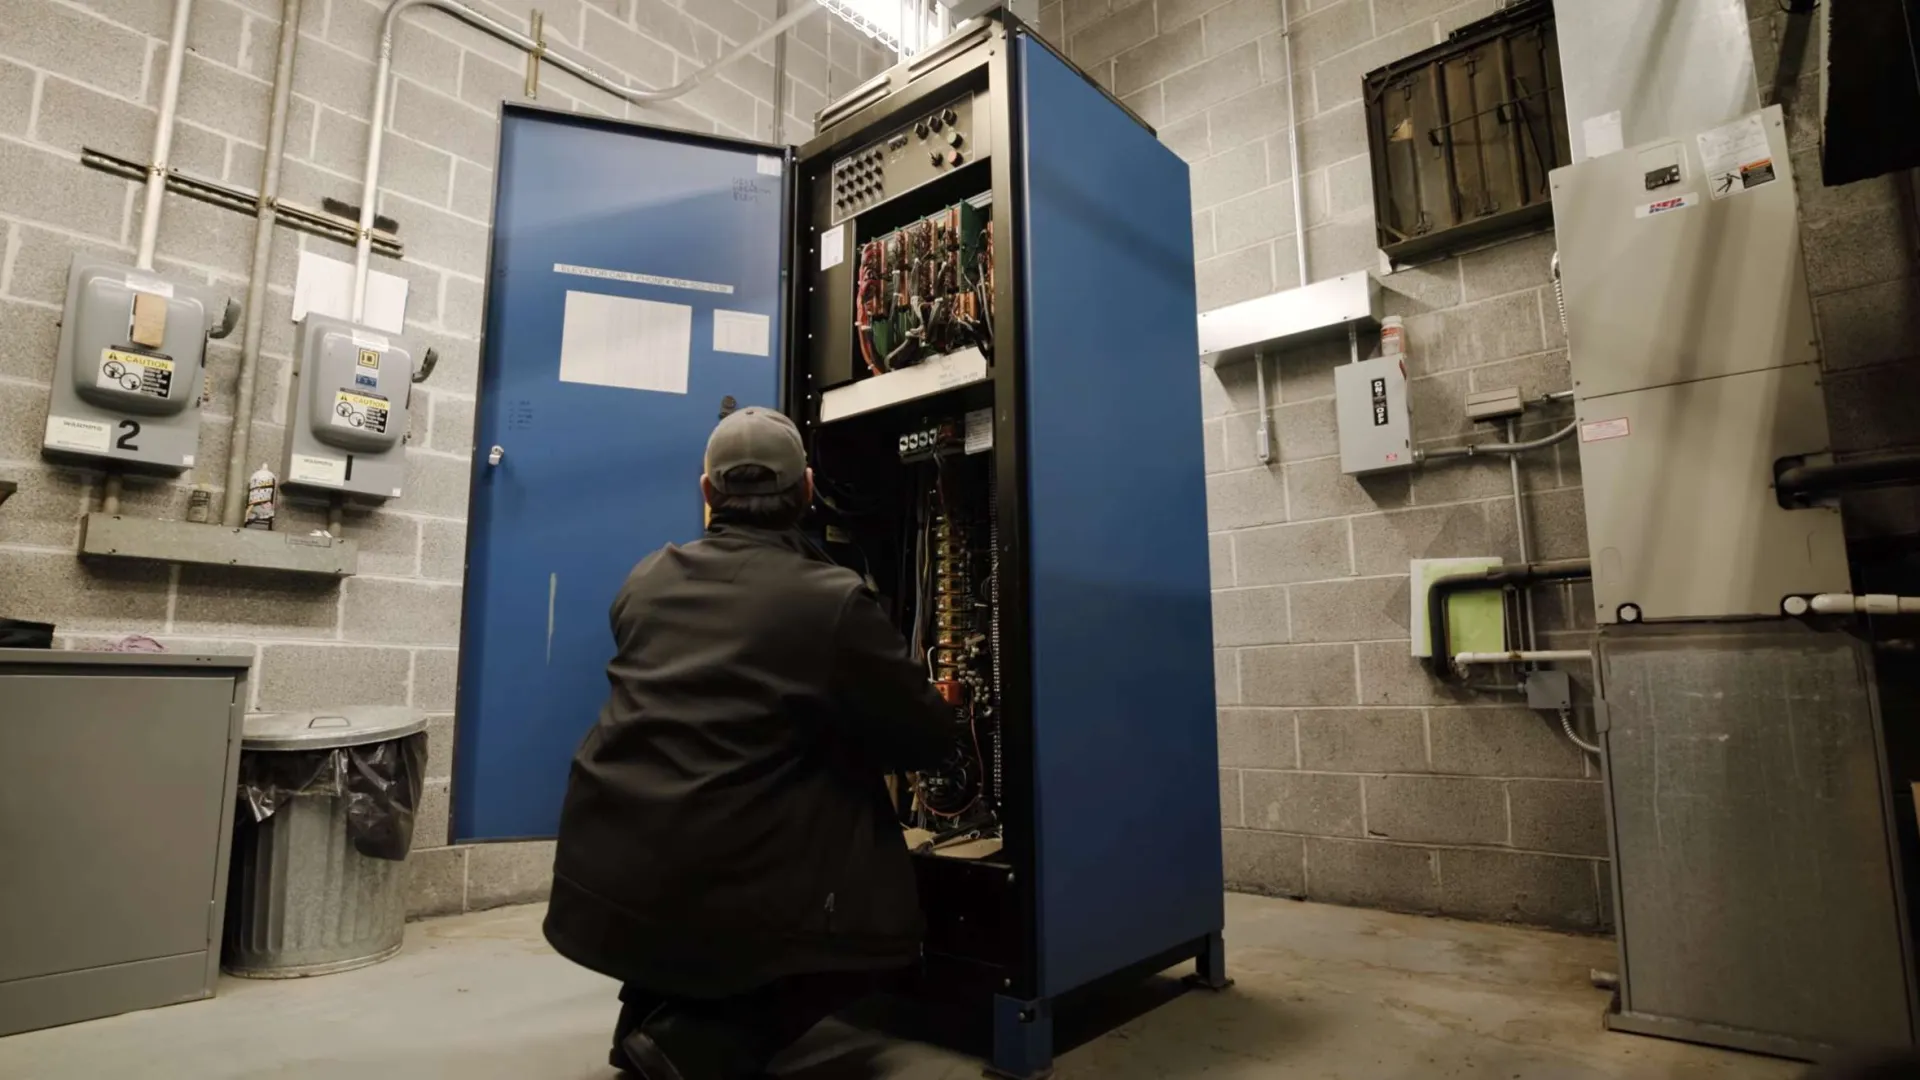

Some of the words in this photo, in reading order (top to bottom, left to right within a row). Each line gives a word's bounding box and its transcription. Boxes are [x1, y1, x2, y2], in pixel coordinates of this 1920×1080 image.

[561, 265, 607, 277] ELEVATOR
[125, 355, 169, 369] CAUTION
[1374, 381, 1383, 393] ON
[352, 396, 386, 409] CAUTION
[1376, 407, 1384, 424] OFF
[116, 419, 141, 451] 2
